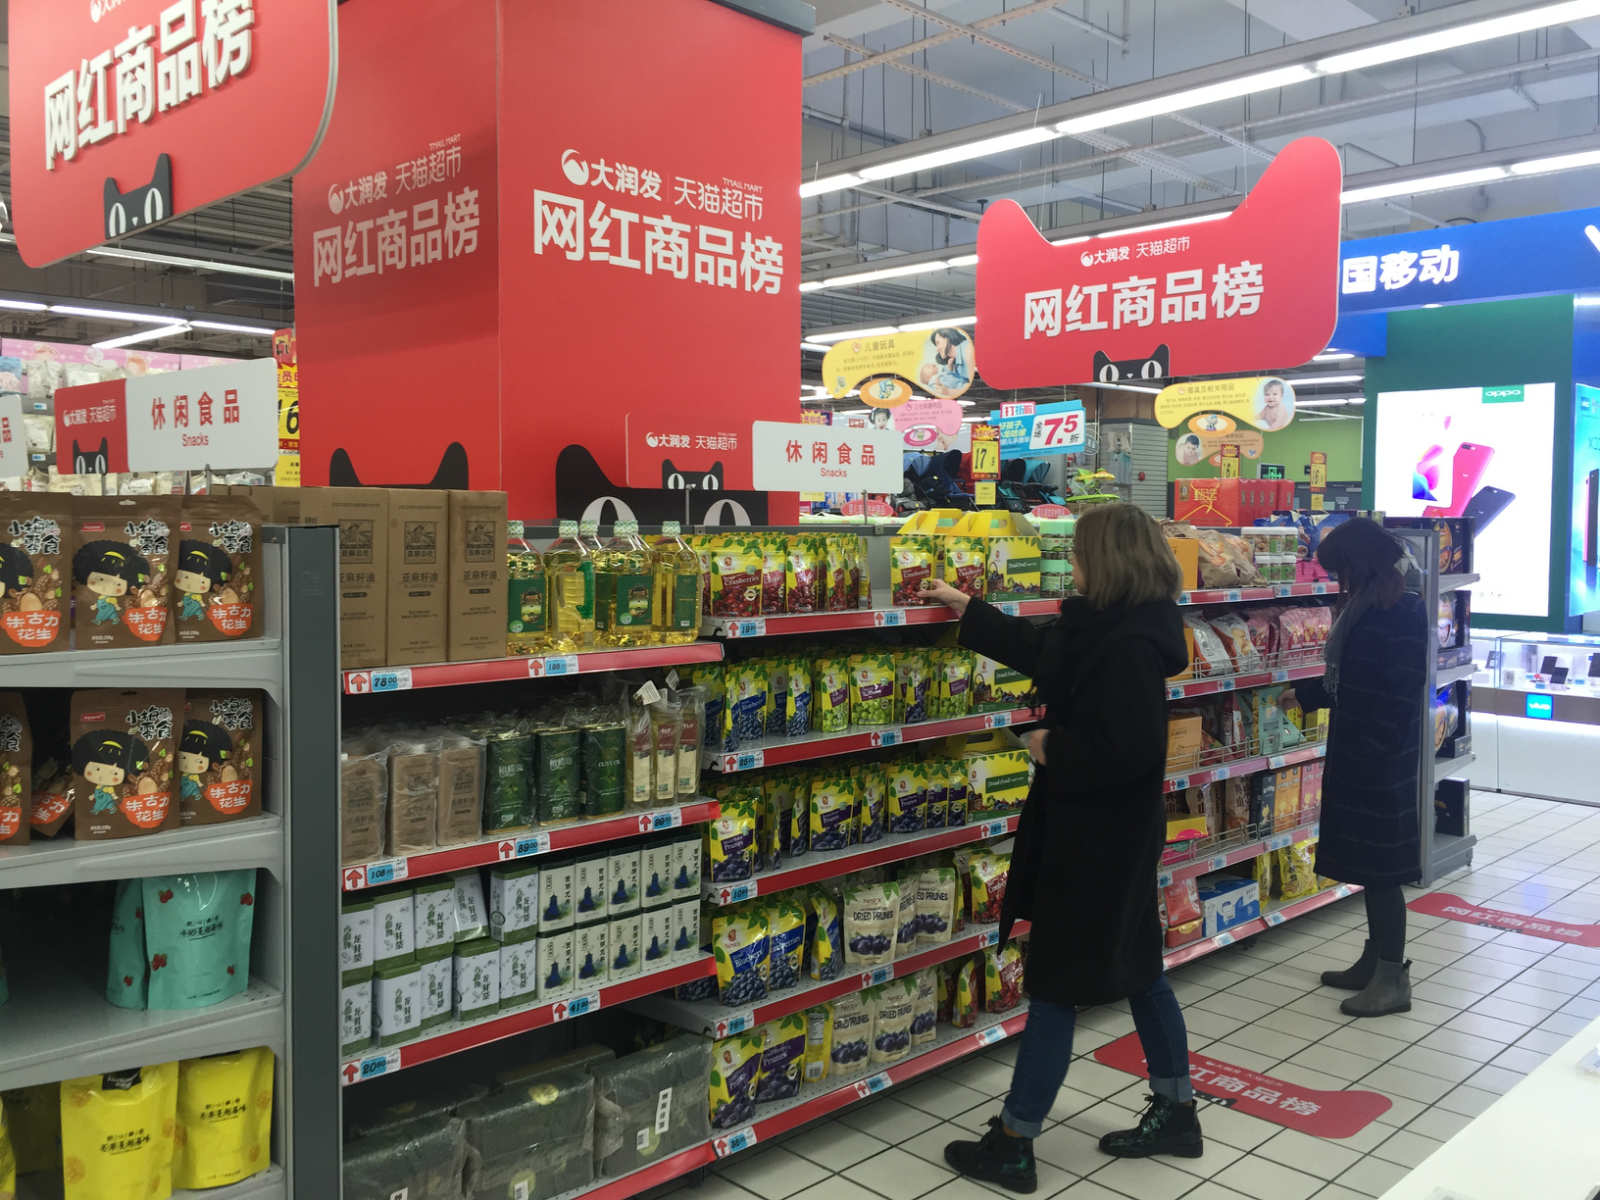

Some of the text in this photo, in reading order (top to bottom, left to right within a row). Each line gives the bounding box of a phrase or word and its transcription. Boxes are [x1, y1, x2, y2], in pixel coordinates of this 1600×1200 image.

[44, 0, 255, 170] 网红商品榜
[345, 146, 462, 210] 大润发 天猫超市
[591, 158, 764, 223] 大润发 天猫超市
[313, 187, 480, 288] 网红商品榜
[533, 188, 785, 295] 网红商品榜
[1093, 235, 1191, 265] 大润发 天猫超市
[1024, 260, 1264, 340] 网红商品榜
[151, 389, 240, 431] 休闲食品
[1044, 414, 1079, 446] 7.5
[182, 433, 209, 447] Snacks
[659, 434, 738, 451] 大润发 天猫超市
[786, 439, 876, 467] 休闲食品
[820, 467, 848, 478] Snacks
[1188, 1064, 1322, 1116] 红商品榜
